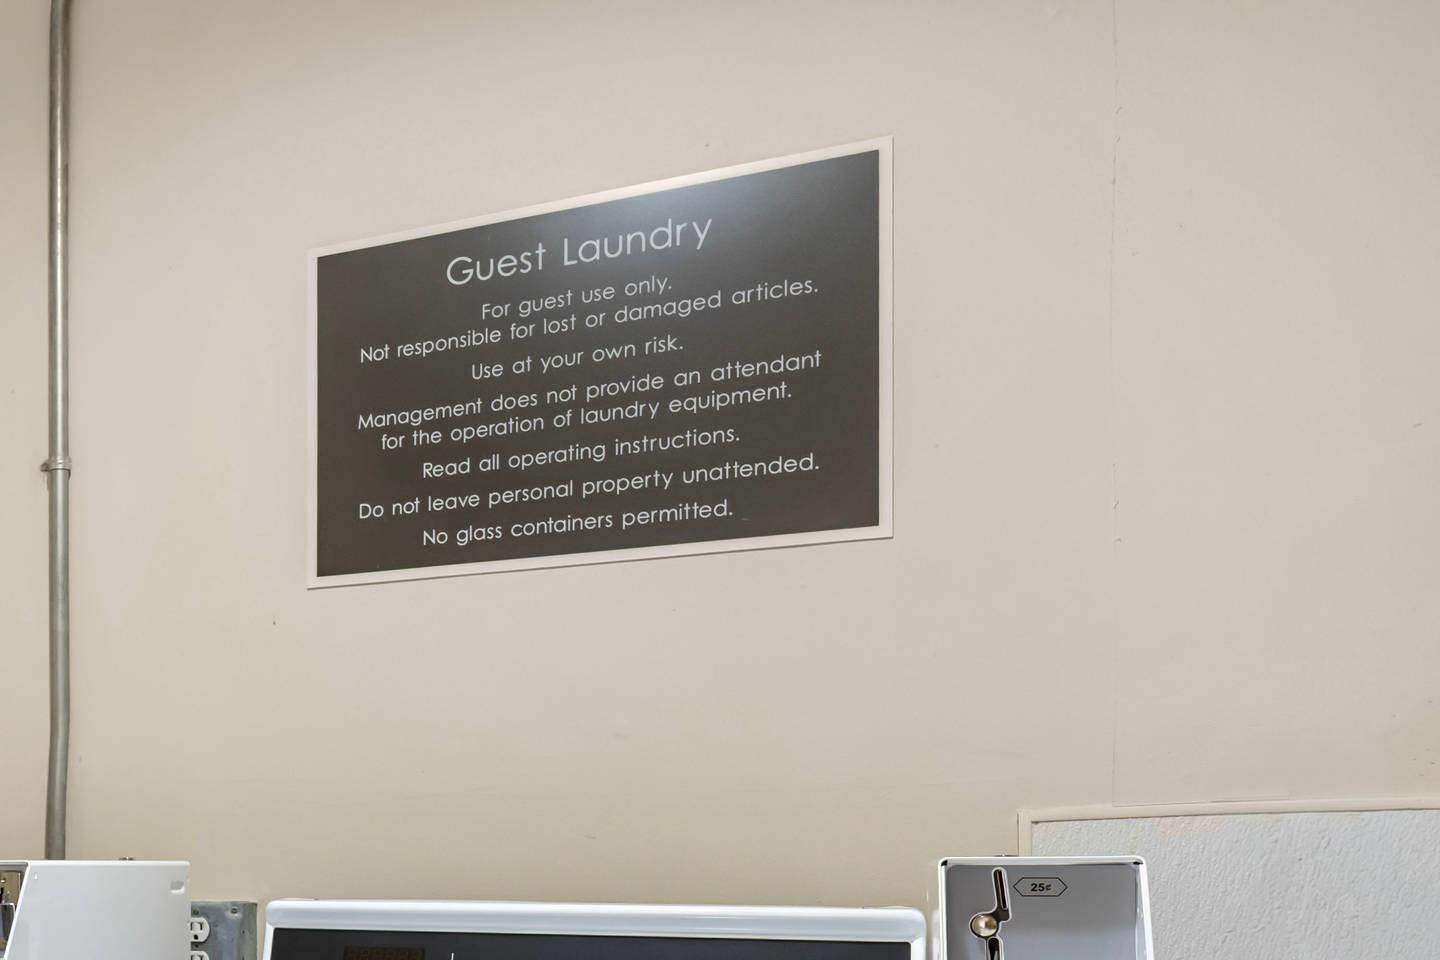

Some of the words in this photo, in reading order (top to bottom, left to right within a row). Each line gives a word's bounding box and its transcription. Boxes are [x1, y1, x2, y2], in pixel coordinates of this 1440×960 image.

[446, 242, 547, 286] Guest
[563, 218, 712, 266] Laundry
[360, 343, 391, 364] Not
[397, 327, 502, 358] responsible
[509, 322, 536, 340] for
[543, 313, 577, 335] lost
[585, 312, 606, 328] or
[614, 289, 721, 323] damaged
[731, 279, 819, 305] articles.
[482, 303, 511, 321] For
[518, 289, 573, 318] guest
[581, 286, 615, 304] use
[624, 275, 672, 296] only.
[357, 397, 483, 430] Management
[490, 393, 538, 412] does
[546, 384, 578, 404] not
[586, 373, 665, 403] provide
[673, 370, 701, 387] an
[710, 349, 822, 382] attendant
[471, 363, 504, 380] Use
[512, 355, 533, 374] at
[540, 351, 584, 374] your
[592, 344, 636, 362] own
[645, 334, 684, 355] risk.
[381, 433, 406, 450] for
[412, 429, 443, 446] the
[450, 416, 545, 444] operation
[553, 408, 573, 428] of
[580, 400, 660, 425] laundry
[668, 380, 792, 414] equipment.
[359, 503, 385, 520] Do
[392, 496, 421, 516] not
[428, 494, 481, 512] leave
[488, 479, 573, 509] personal
[582, 469, 674, 499] property
[682, 452, 820, 484] unattended.
[422, 456, 471, 479] Read
[478, 453, 500, 472] all
[508, 443, 606, 471] operating
[615, 428, 740, 456] instructions.
[423, 528, 449, 546] No
[456, 524, 503, 546] glass
[510, 514, 613, 537] containers
[622, 498, 733, 530] permitted.
